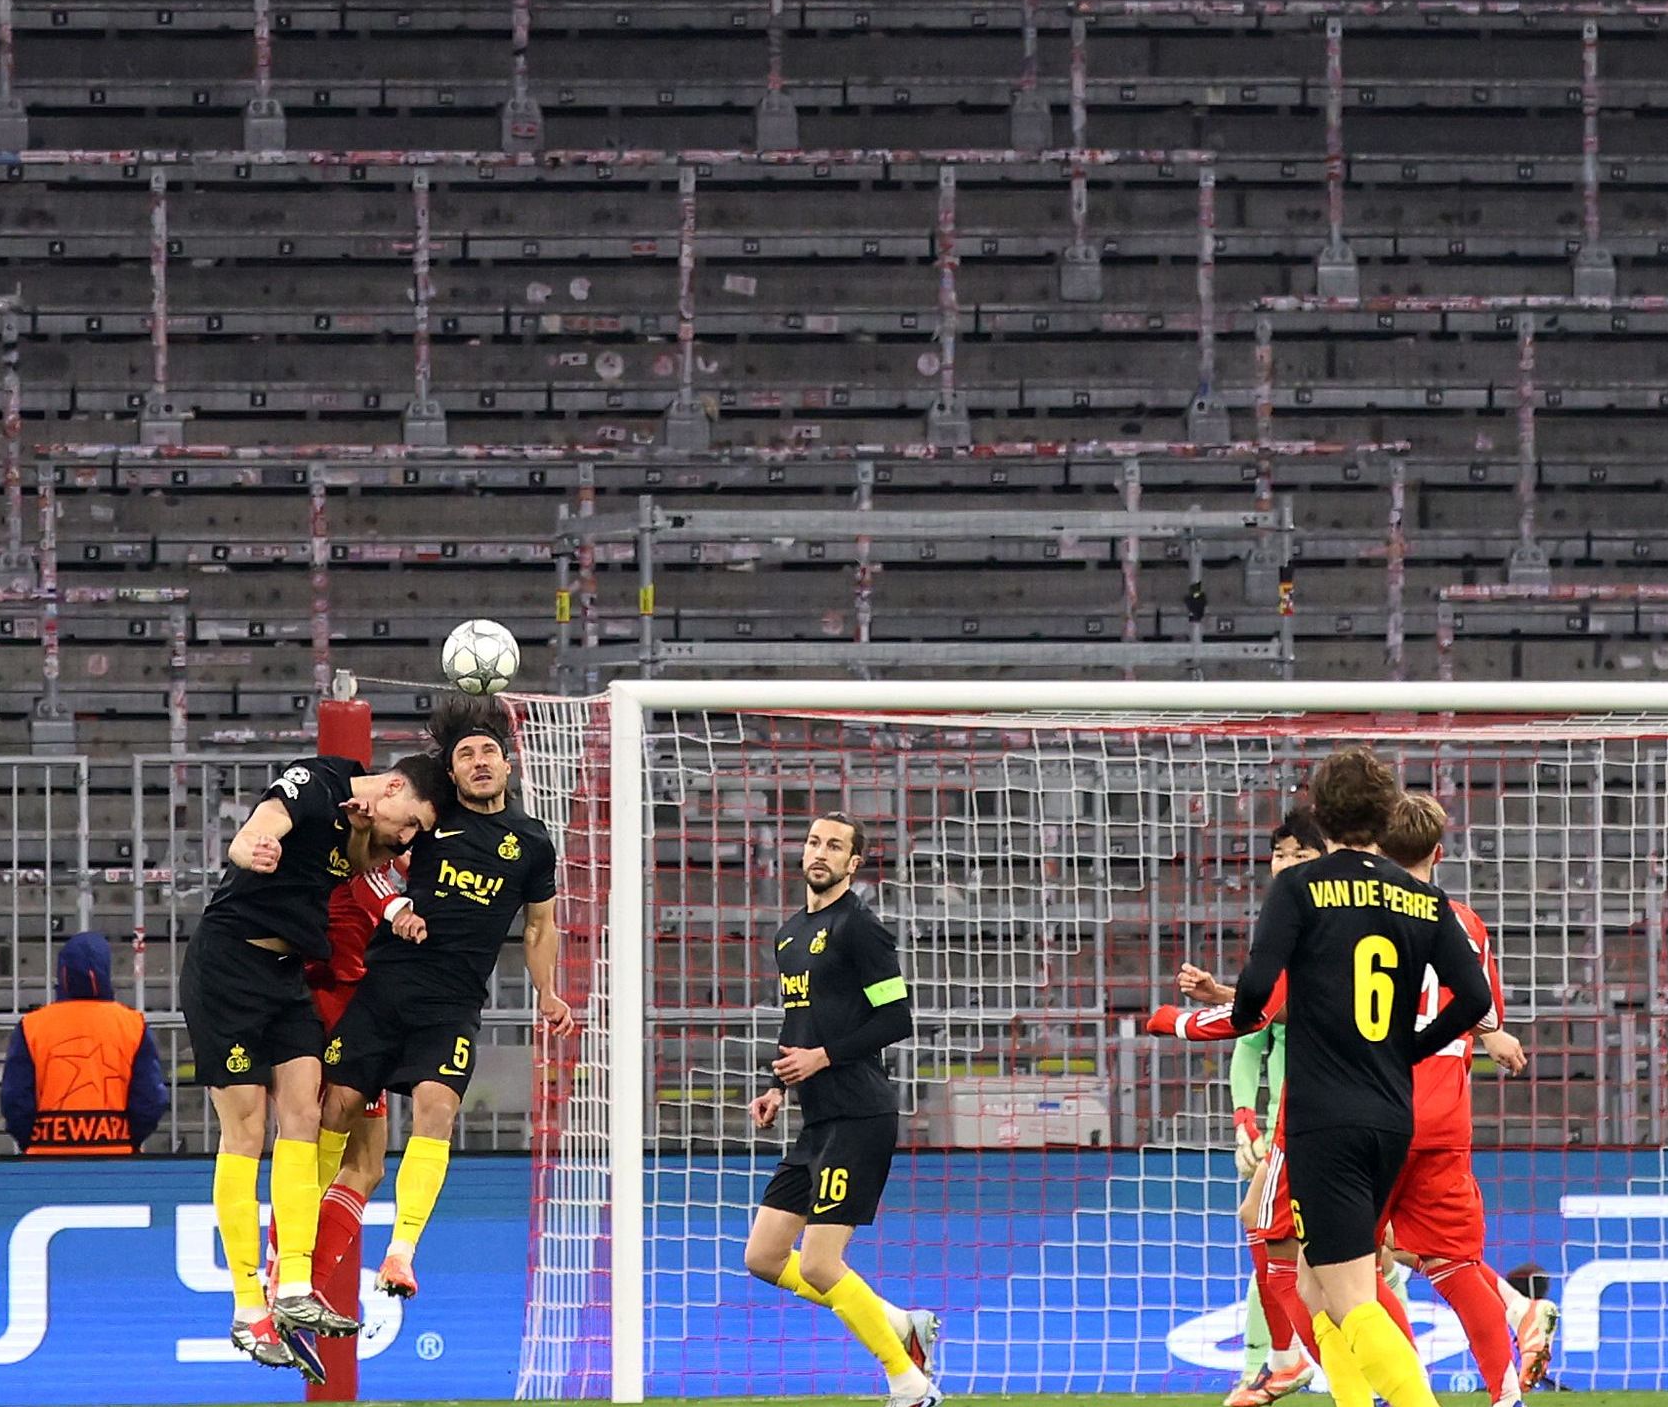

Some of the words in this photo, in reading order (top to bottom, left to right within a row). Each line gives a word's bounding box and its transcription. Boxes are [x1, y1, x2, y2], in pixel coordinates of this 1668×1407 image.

[439, 859, 505, 897] hey!
[1309, 880, 1351, 908] VAN
[1352, 880, 1380, 907] DE
[1382, 881, 1439, 922] PERRE
[780, 969, 811, 999] hey!
[1354, 934, 1399, 1042] 6
[453, 1036, 471, 1070] 5
[818, 1167, 849, 1202] 16
